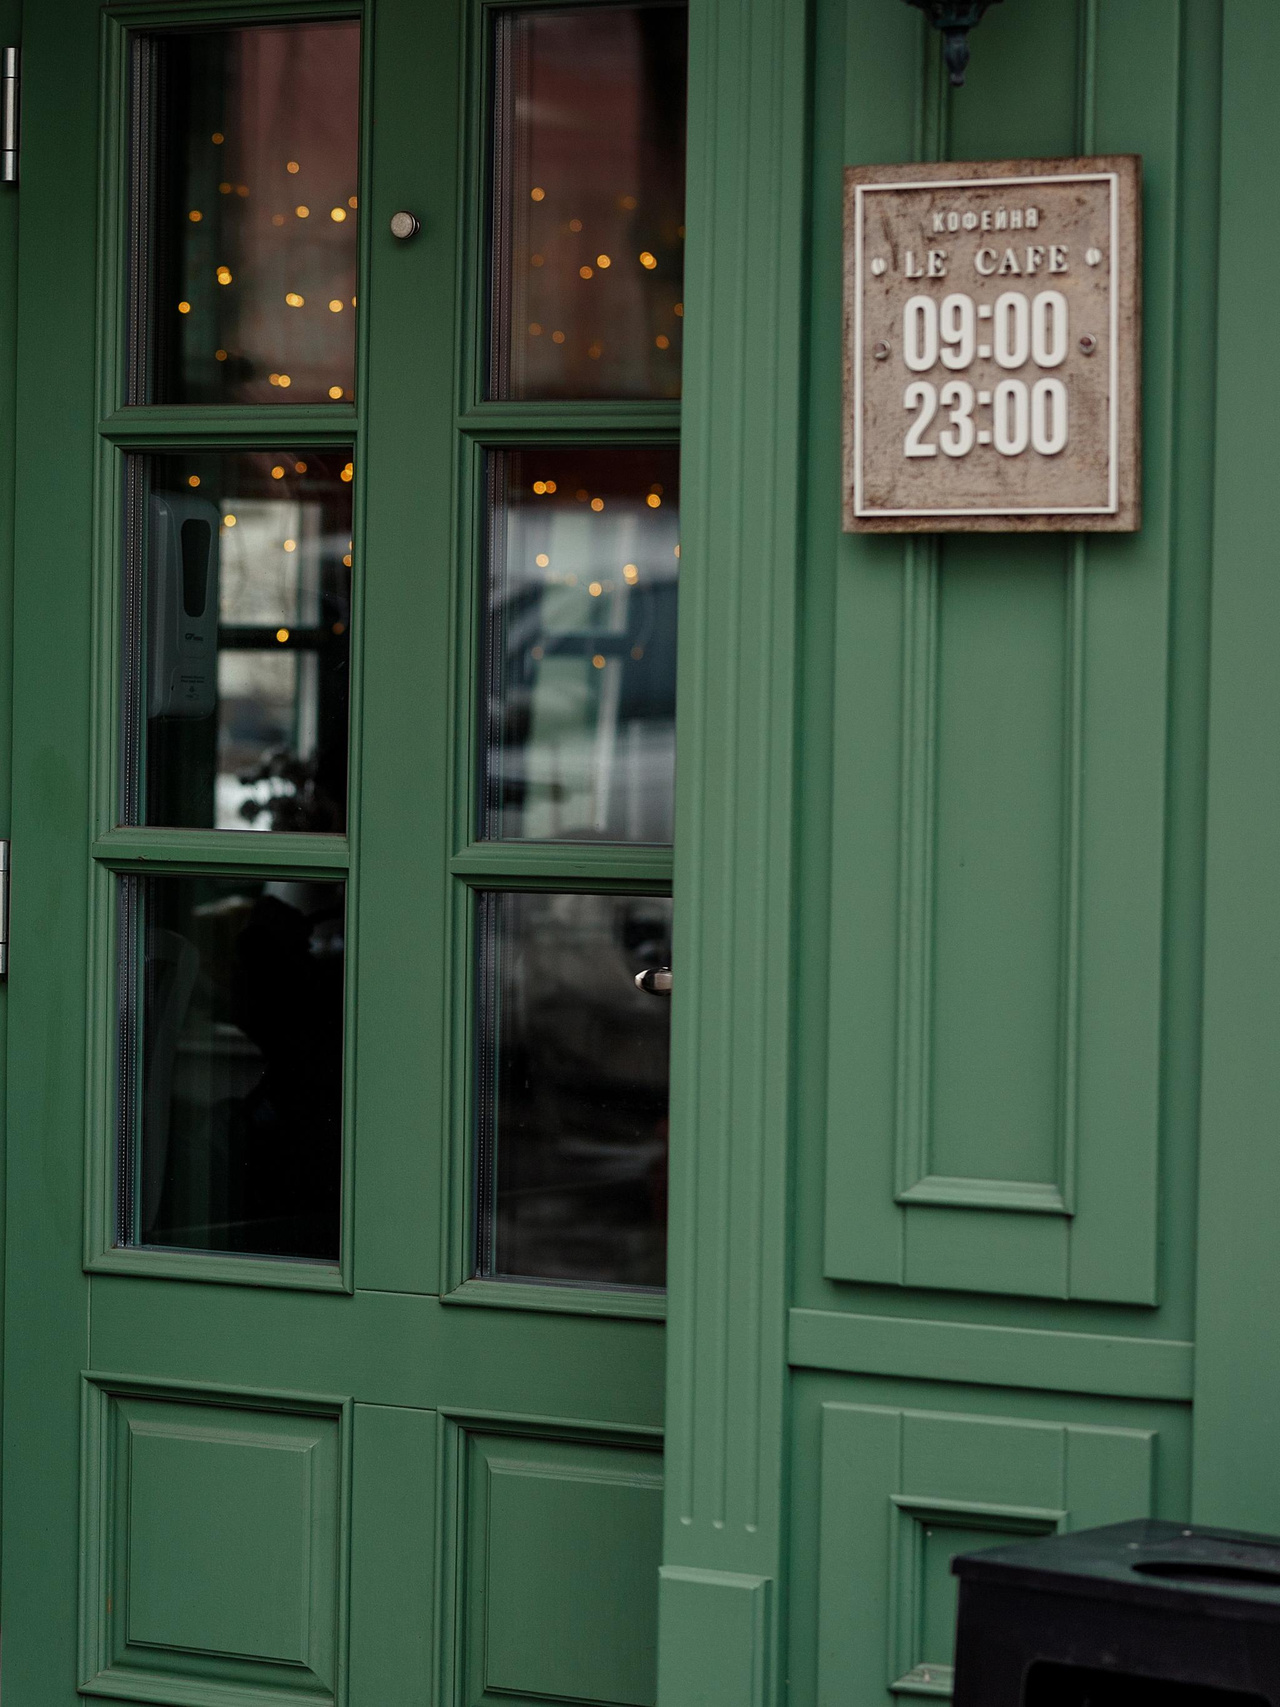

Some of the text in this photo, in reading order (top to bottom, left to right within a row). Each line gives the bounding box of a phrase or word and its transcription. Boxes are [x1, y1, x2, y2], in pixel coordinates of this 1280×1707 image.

[933, 206, 1039, 233] КОФЕЙНЯ
[904, 245, 1069, 278] LE CAFE
[904, 291, 1068, 371] 09:00
[904, 378, 1068, 458] 23:00
